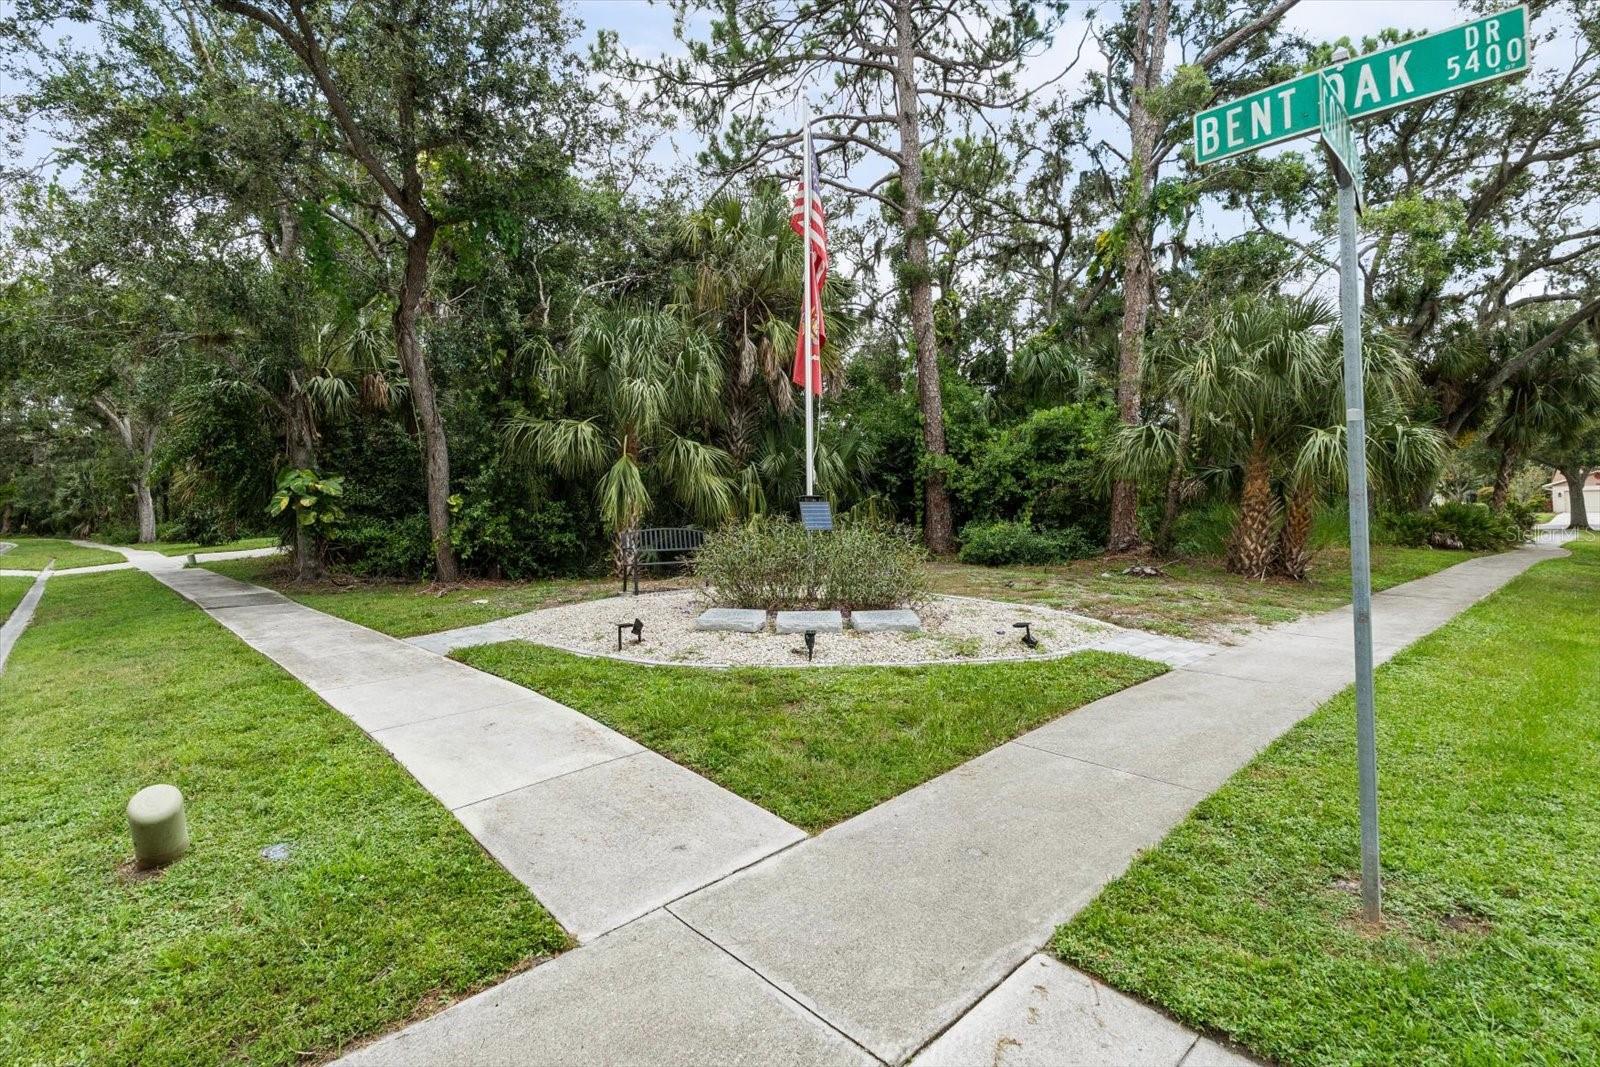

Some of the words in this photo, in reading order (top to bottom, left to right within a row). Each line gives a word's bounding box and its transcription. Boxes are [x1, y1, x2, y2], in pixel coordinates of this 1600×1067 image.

[1201, 87, 1296, 156] BENT
[1464, 19, 1500, 51] DR
[1447, 37, 1522, 80] 5400
